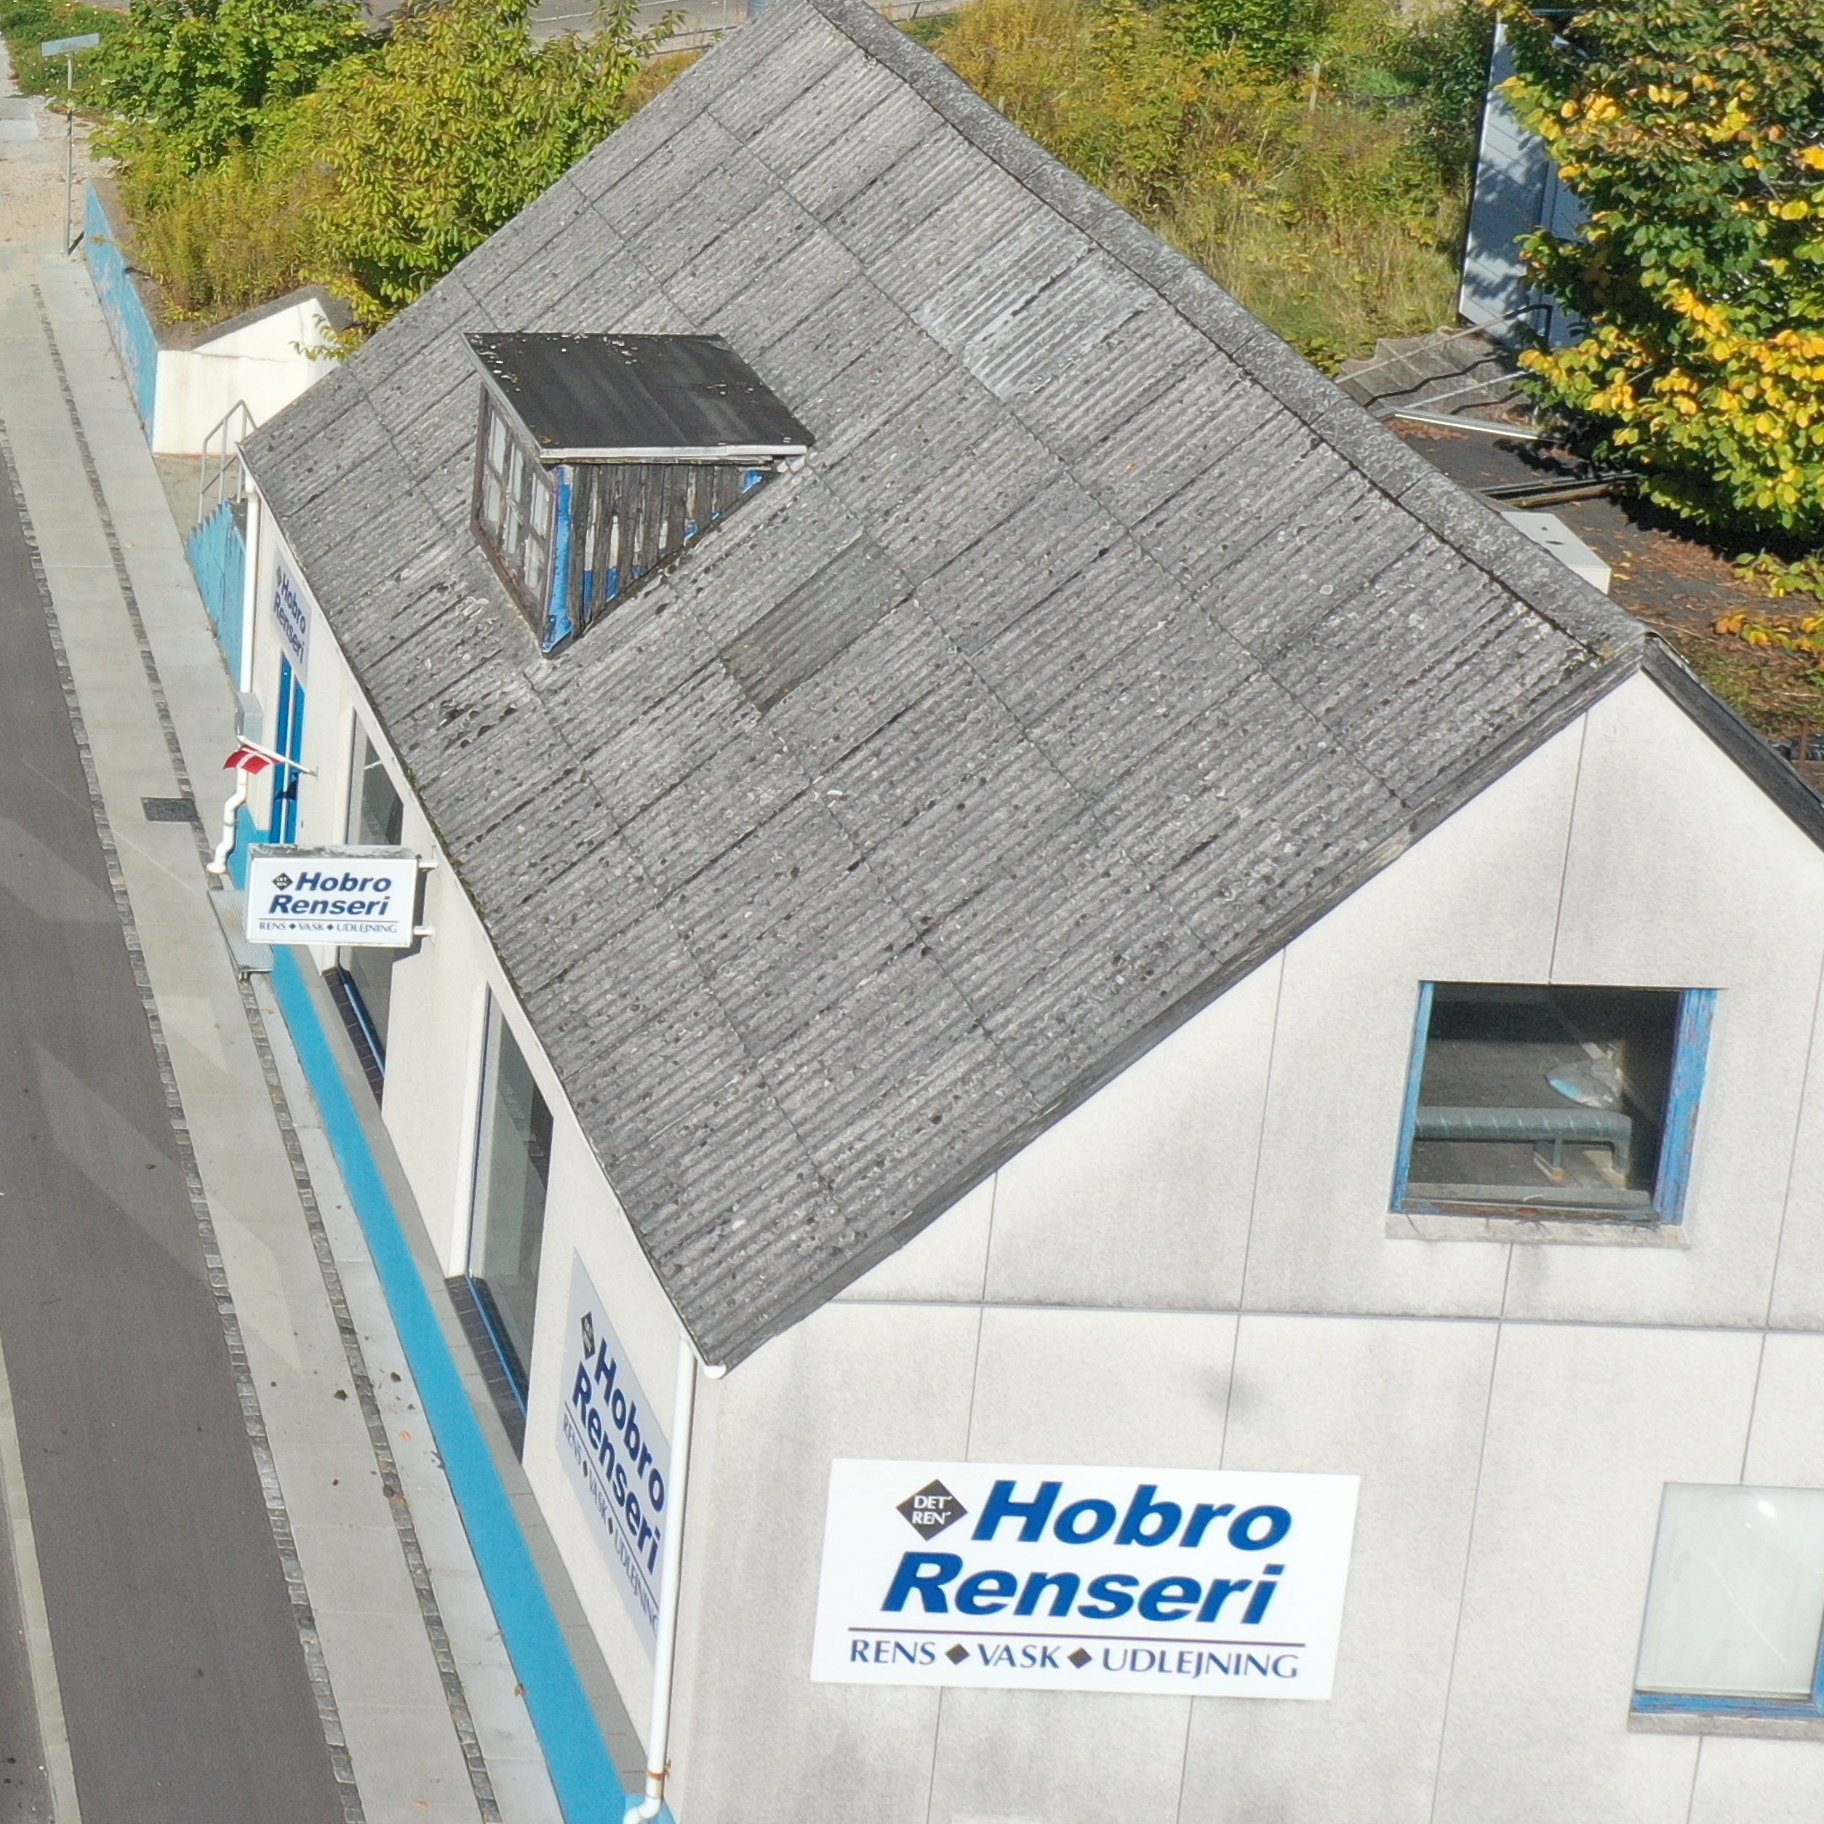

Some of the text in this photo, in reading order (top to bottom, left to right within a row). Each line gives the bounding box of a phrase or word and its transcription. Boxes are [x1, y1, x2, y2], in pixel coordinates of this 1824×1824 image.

[273, 591, 305, 664] Renseri
[281, 573, 306, 634] Hobro
[269, 894, 390, 915] Renseri
[295, 871, 392, 892] Hobro
[259, 922, 398, 933] RENS VASK UDLEJNING
[594, 1336, 665, 1512] Hobro
[572, 1360, 661, 1575] Renseri
[970, 1479, 1293, 1552] Hobro
[879, 1550, 1286, 1625] Renseri
[849, 1639, 1301, 1679] RENS VASK UDLEJNING
